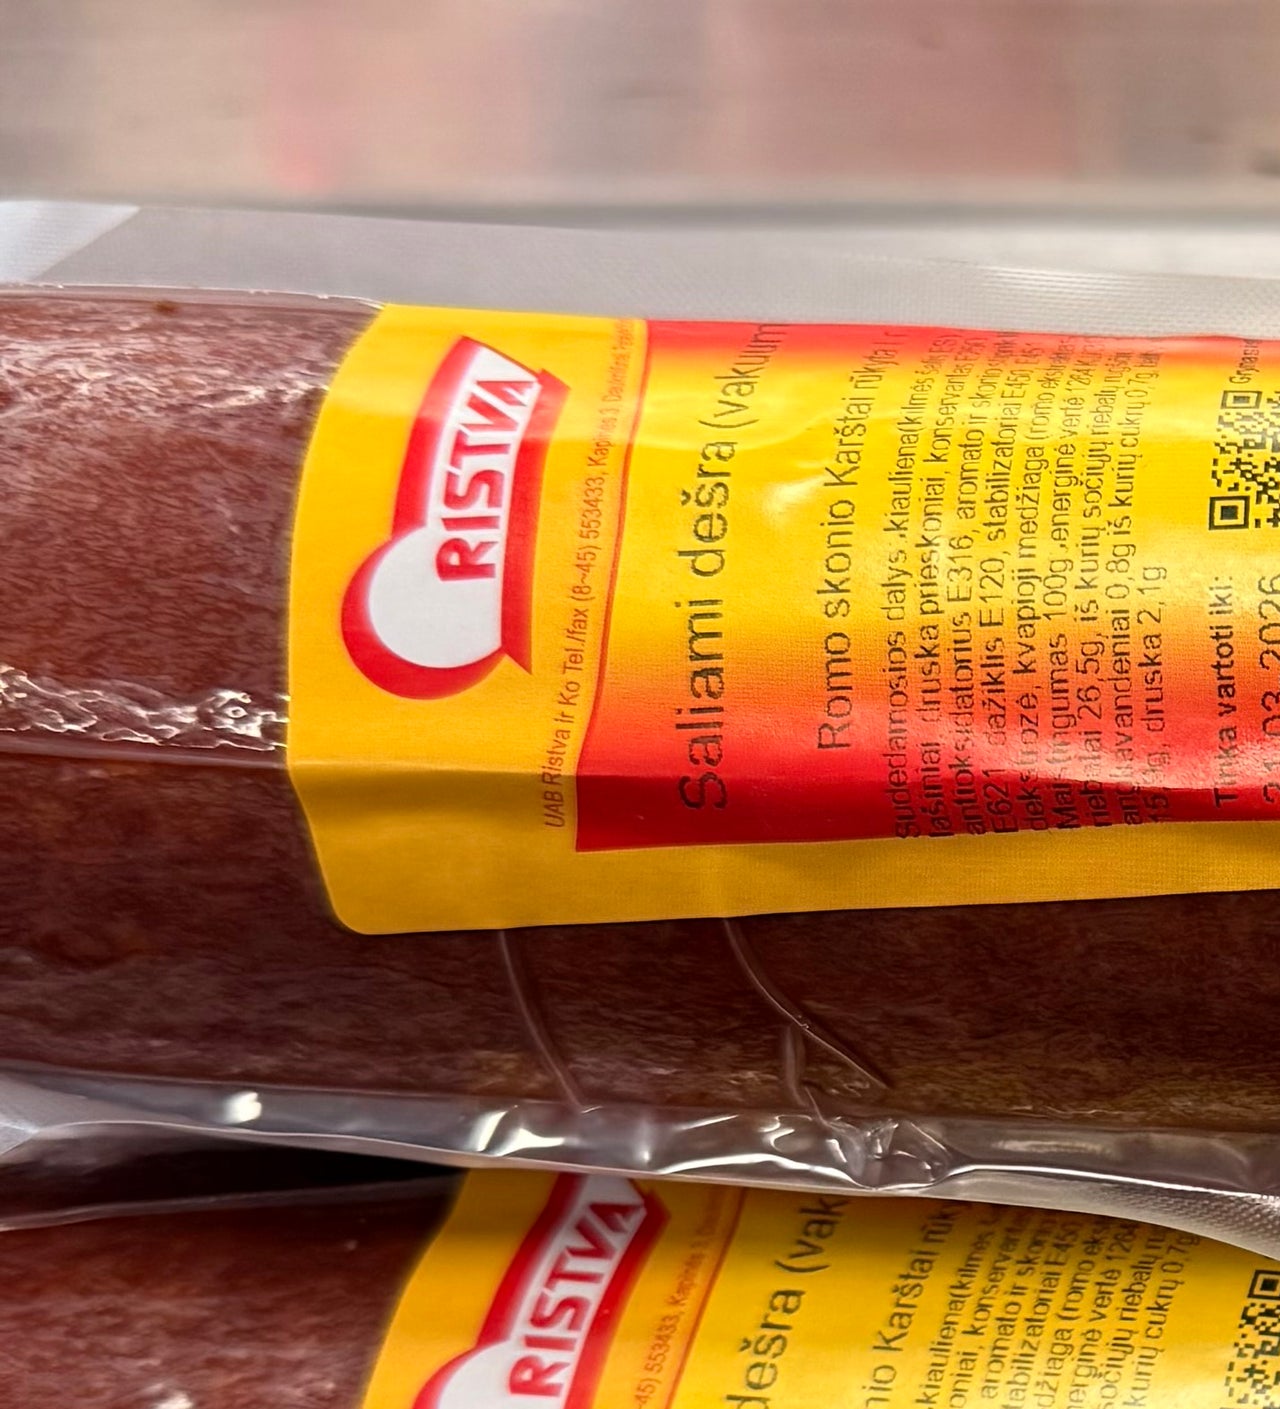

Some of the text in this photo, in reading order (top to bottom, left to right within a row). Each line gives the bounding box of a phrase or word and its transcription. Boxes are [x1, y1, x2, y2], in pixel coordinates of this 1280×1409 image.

[823, 397, 876, 487] Karštai
[961, 414, 988, 425] ir
[1022, 393, 1058, 440] (romo
[1057, 397, 1086, 439] vertė
[1086, 385, 1125, 436] riebalų
[1118, 401, 1155, 448] cukrų
[435, 379, 534, 582] RISTVA
[578, 471, 608, 540] 553433,
[954, 429, 985, 520] aromato
[981, 403, 1023, 542] stabilizatoriai
[1014, 446, 1049, 559] medžiaga
[1078, 441, 1114, 519] sočiųjų
[1107, 454, 1143, 508] kurių
[677, 441, 738, 577] dešra
[1106, 515, 1130, 536] iš
[815, 499, 856, 618] skonio
[946, 528, 980, 602] E316,
[978, 550, 1011, 628] E120,
[1074, 526, 1107, 590] kurių
[1104, 544, 1136, 600] 0,8g
[1011, 568, 1042, 674] kvapioji
[1074, 600, 1099, 622] iš
[1135, 567, 1167, 625] 2,1g
[557, 681, 582, 706] Ko
[675, 598, 729, 810] Saliami
[816, 631, 853, 750] Romo
[981, 638, 1007, 746] dažiklis
[1138, 633, 1165, 733] druska
[1208, 575, 1238, 808] Tinka vartoti iki:
[541, 729, 572, 785] Ristva
[947, 612, 986, 835] antioksidatorius
[543, 791, 567, 827] UAB
[508, 1203, 636, 1397] RISTVA
[870, 1250, 941, 1352] Karštai
[998, 1284, 1029, 1296] ir
[1056, 1260, 1097, 1320] (romo
[1089, 1269, 1122, 1322] vertė
[1116, 1254, 1164, 1322] riebalų
[1143, 1279, 1185, 1339] cukrų
[978, 1302, 1021, 1399] aromato
[1122, 1346, 1165, 1407] kurių
